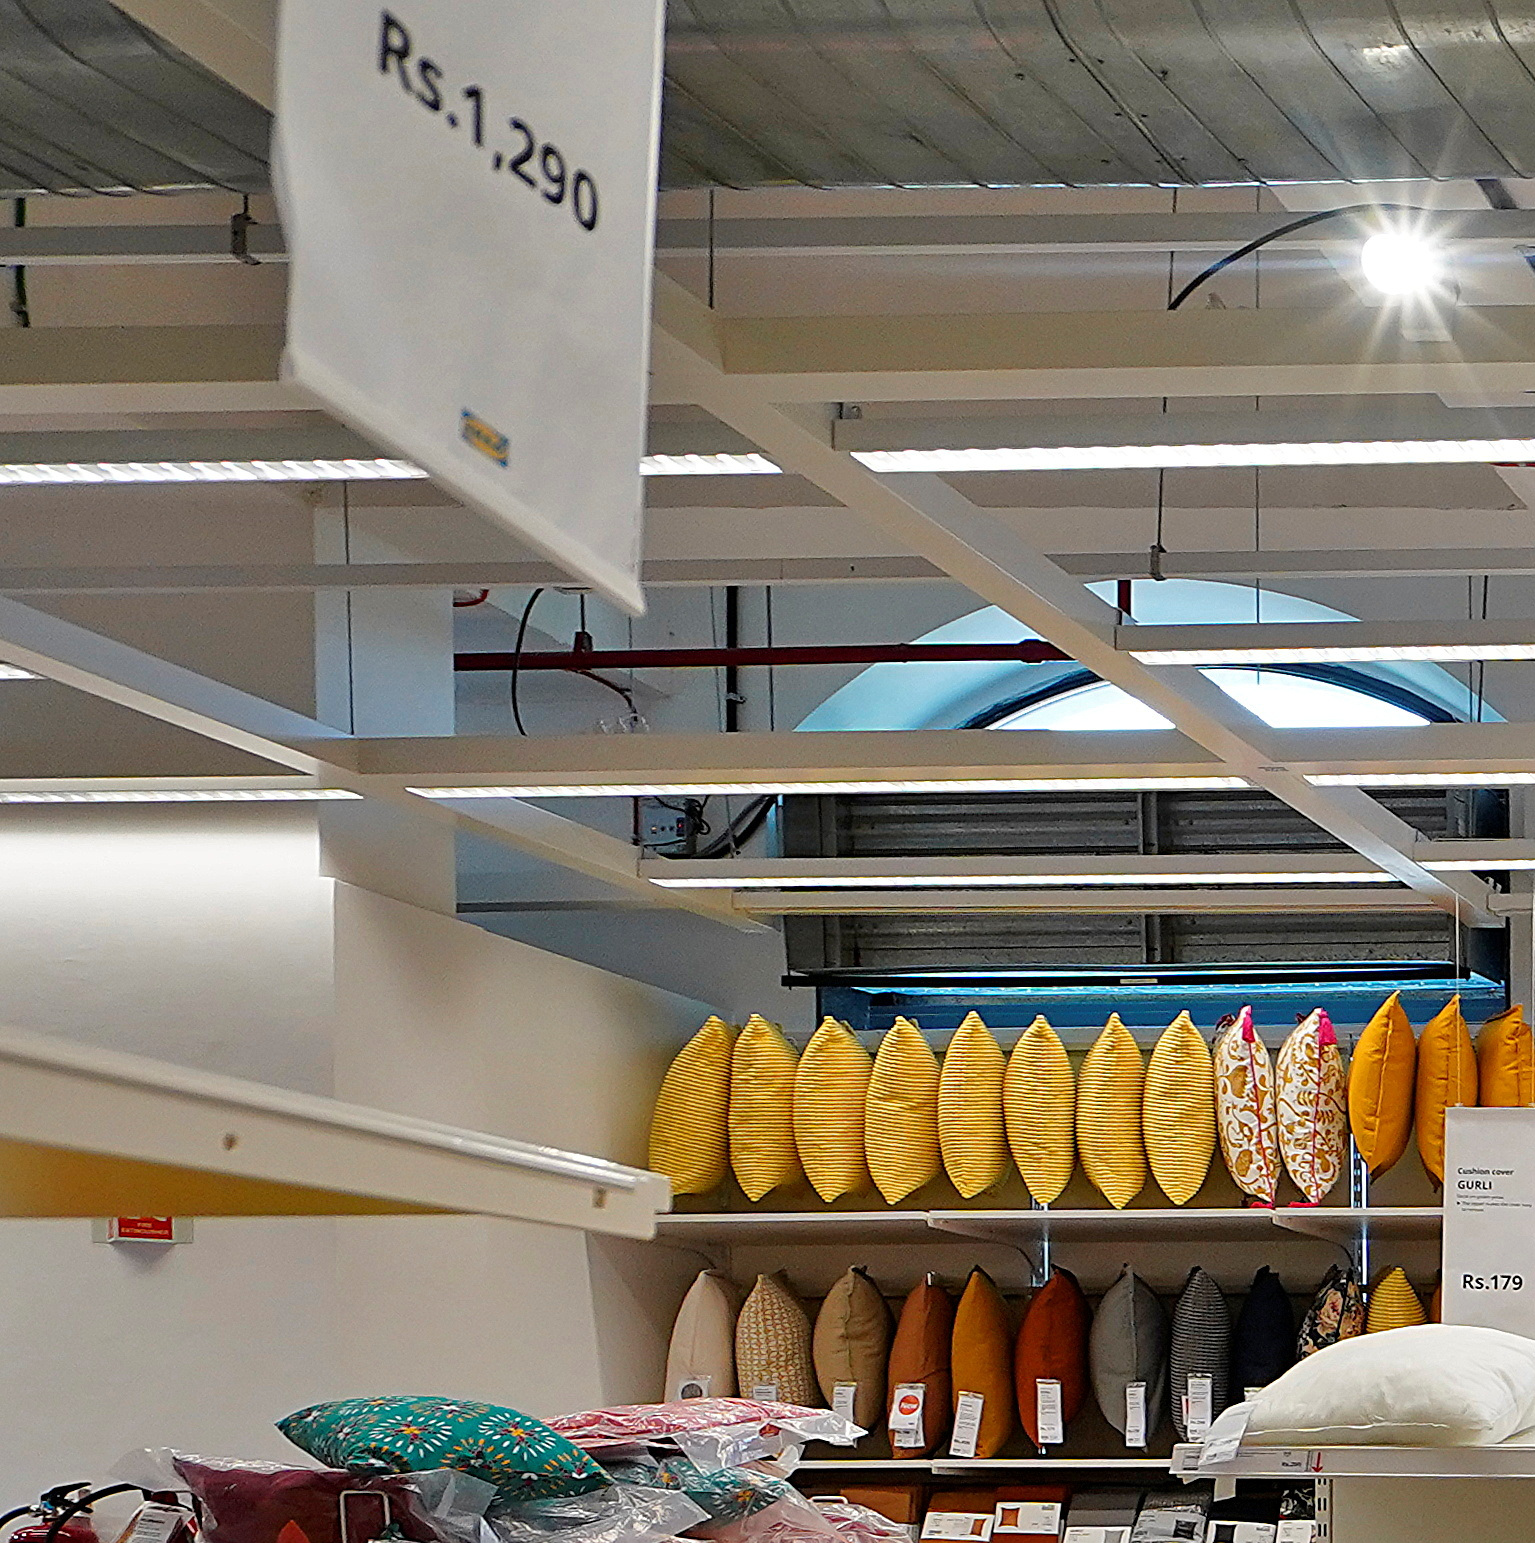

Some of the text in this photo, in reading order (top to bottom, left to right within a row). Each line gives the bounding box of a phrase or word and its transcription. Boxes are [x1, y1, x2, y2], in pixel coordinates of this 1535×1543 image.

[378, 8, 599, 232] Rs.1,290
[1457, 1167, 1514, 1176] Cushion cover
[1457, 1180, 1492, 1190] GURLI
[1462, 1274, 1523, 1291] Rs.179
